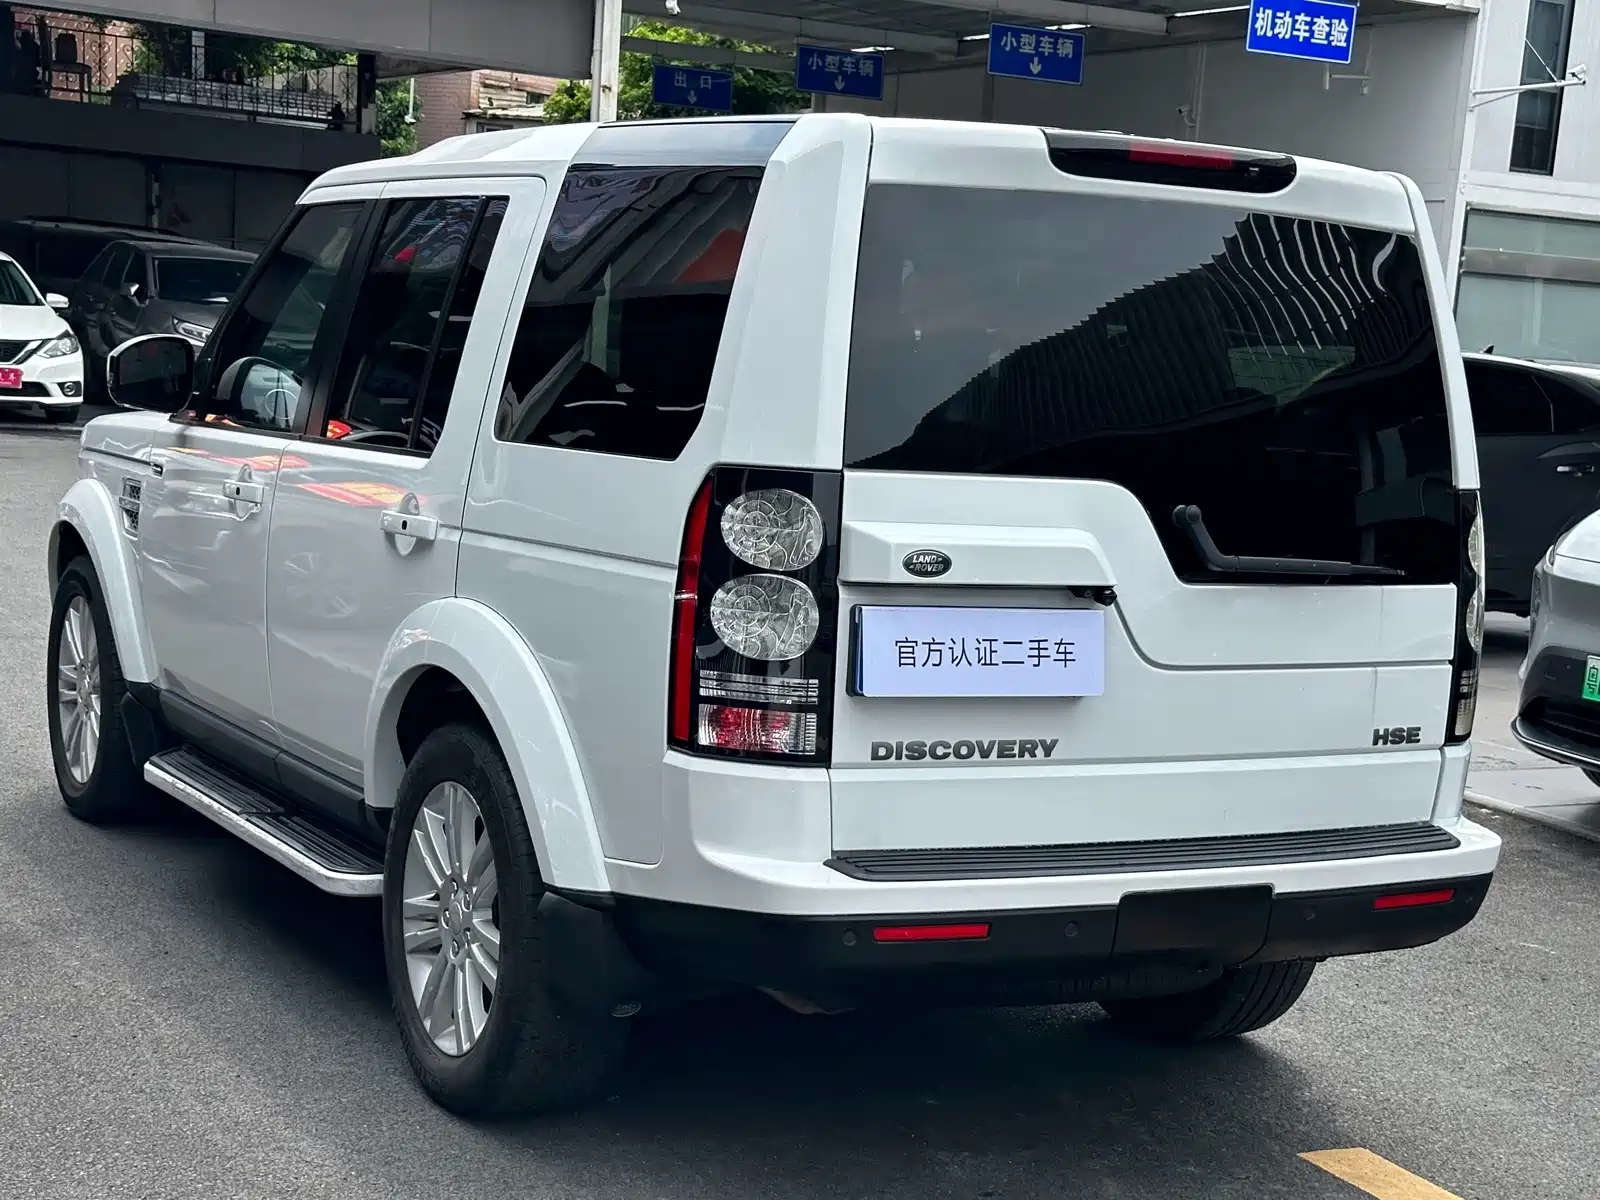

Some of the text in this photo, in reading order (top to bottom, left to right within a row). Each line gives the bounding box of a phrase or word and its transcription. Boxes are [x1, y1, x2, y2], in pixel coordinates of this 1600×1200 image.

[1255, 7, 1349, 47] 机动车查验
[1000, 32, 1074, 59] 小型车辆
[808, 53, 875, 77] 小型车辆
[674, 71, 712, 90] 出口
[912, 554, 938, 564] LAND
[914, 563, 945, 572] ROVER
[1372, 726, 1422, 746] HSE
[870, 739, 1060, 761] DISCOVERY
